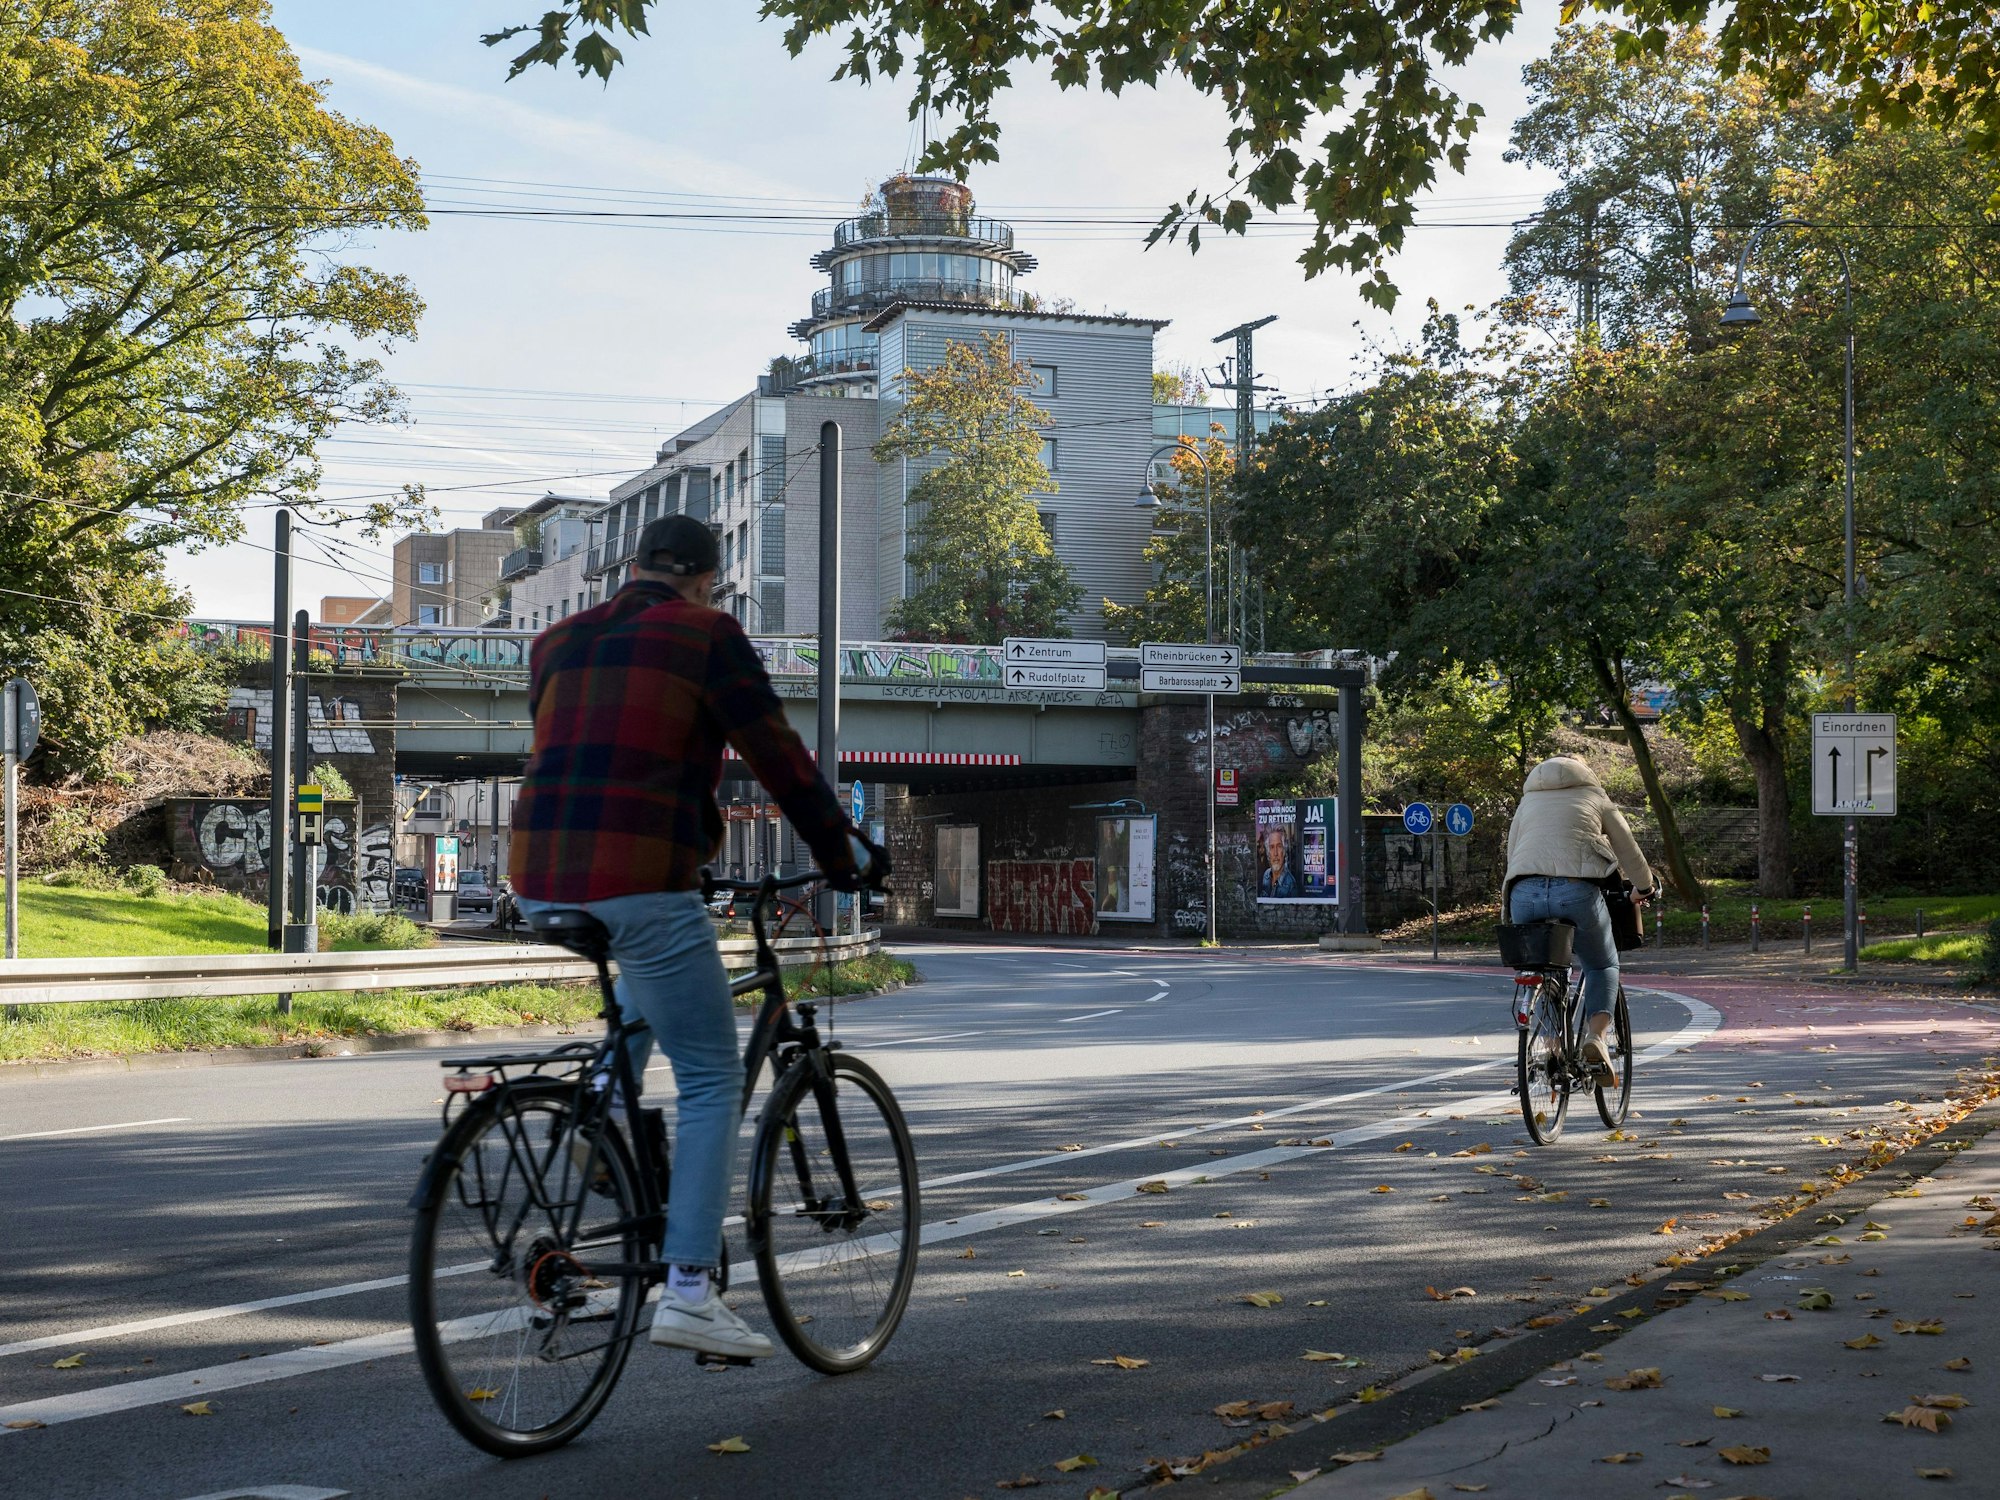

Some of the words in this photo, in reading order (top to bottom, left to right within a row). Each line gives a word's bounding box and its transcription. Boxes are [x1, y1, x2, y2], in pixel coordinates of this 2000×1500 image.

[1029, 646, 1072, 658] Zentrum
[1150, 650, 1218, 662] Rheinbrücken
[1028, 671, 1086, 684] Rudolfplatz
[1159, 675, 1217, 688] Barbarossaplatz
[1822, 721, 1886, 732] Einordnen
[1258, 806, 1270, 814] SIND
[1270, 806, 1281, 814] WIR
[1282, 805, 1296, 814] NOCH
[1304, 804, 1324, 823] JA!
[1259, 815, 1268, 824] ZU
[1269, 814, 1296, 824] RETTEN?
[300, 815, 320, 842] H
[1303, 854, 1324, 864] WELT
[987, 857, 1098, 934] ULTRAS
